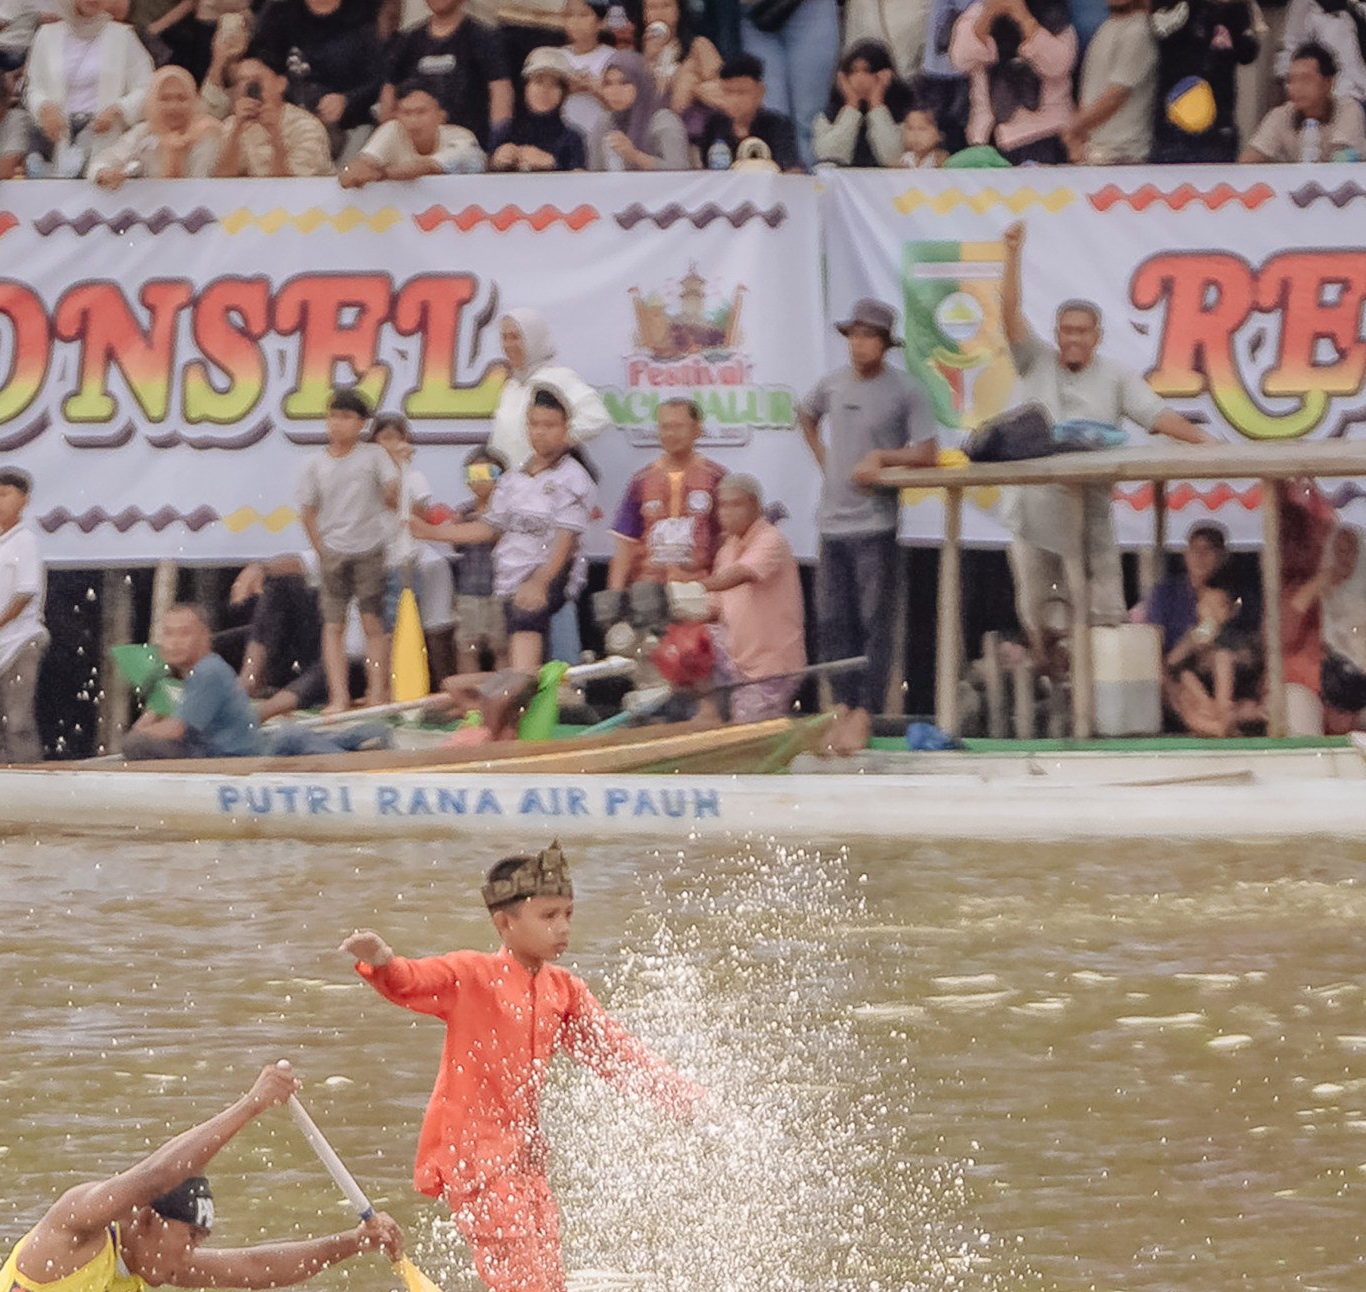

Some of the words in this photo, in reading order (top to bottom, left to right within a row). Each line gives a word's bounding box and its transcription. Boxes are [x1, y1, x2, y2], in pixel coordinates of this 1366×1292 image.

[217, 785, 354, 815] PUTRI
[377, 786, 504, 816] RANA
[519, 786, 591, 817] AIR
[605, 787, 722, 819] PAUH
